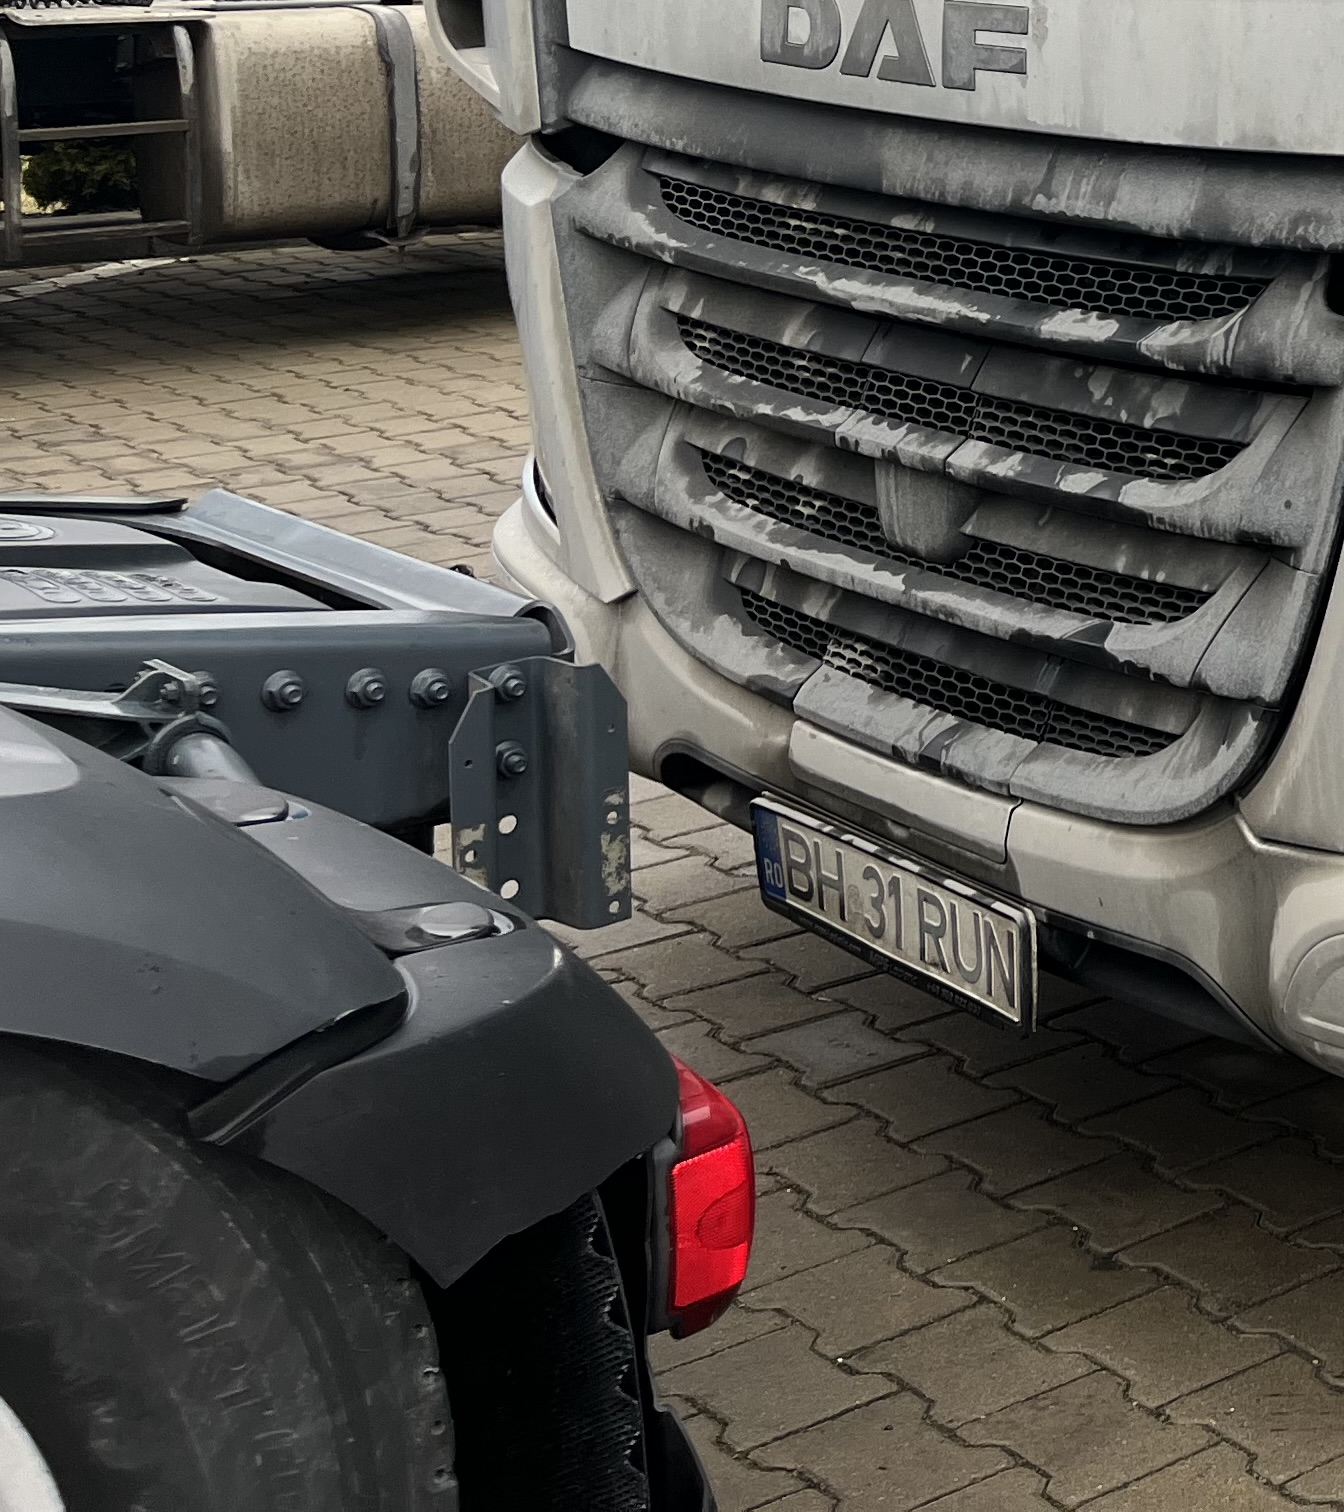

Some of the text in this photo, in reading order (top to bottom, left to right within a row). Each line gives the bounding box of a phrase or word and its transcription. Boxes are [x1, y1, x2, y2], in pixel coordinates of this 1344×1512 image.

[764, 857, 783, 889] RO
[782, 823, 847, 922] BH
[862, 863, 903, 950] 31
[917, 885, 1017, 1009] RUN
